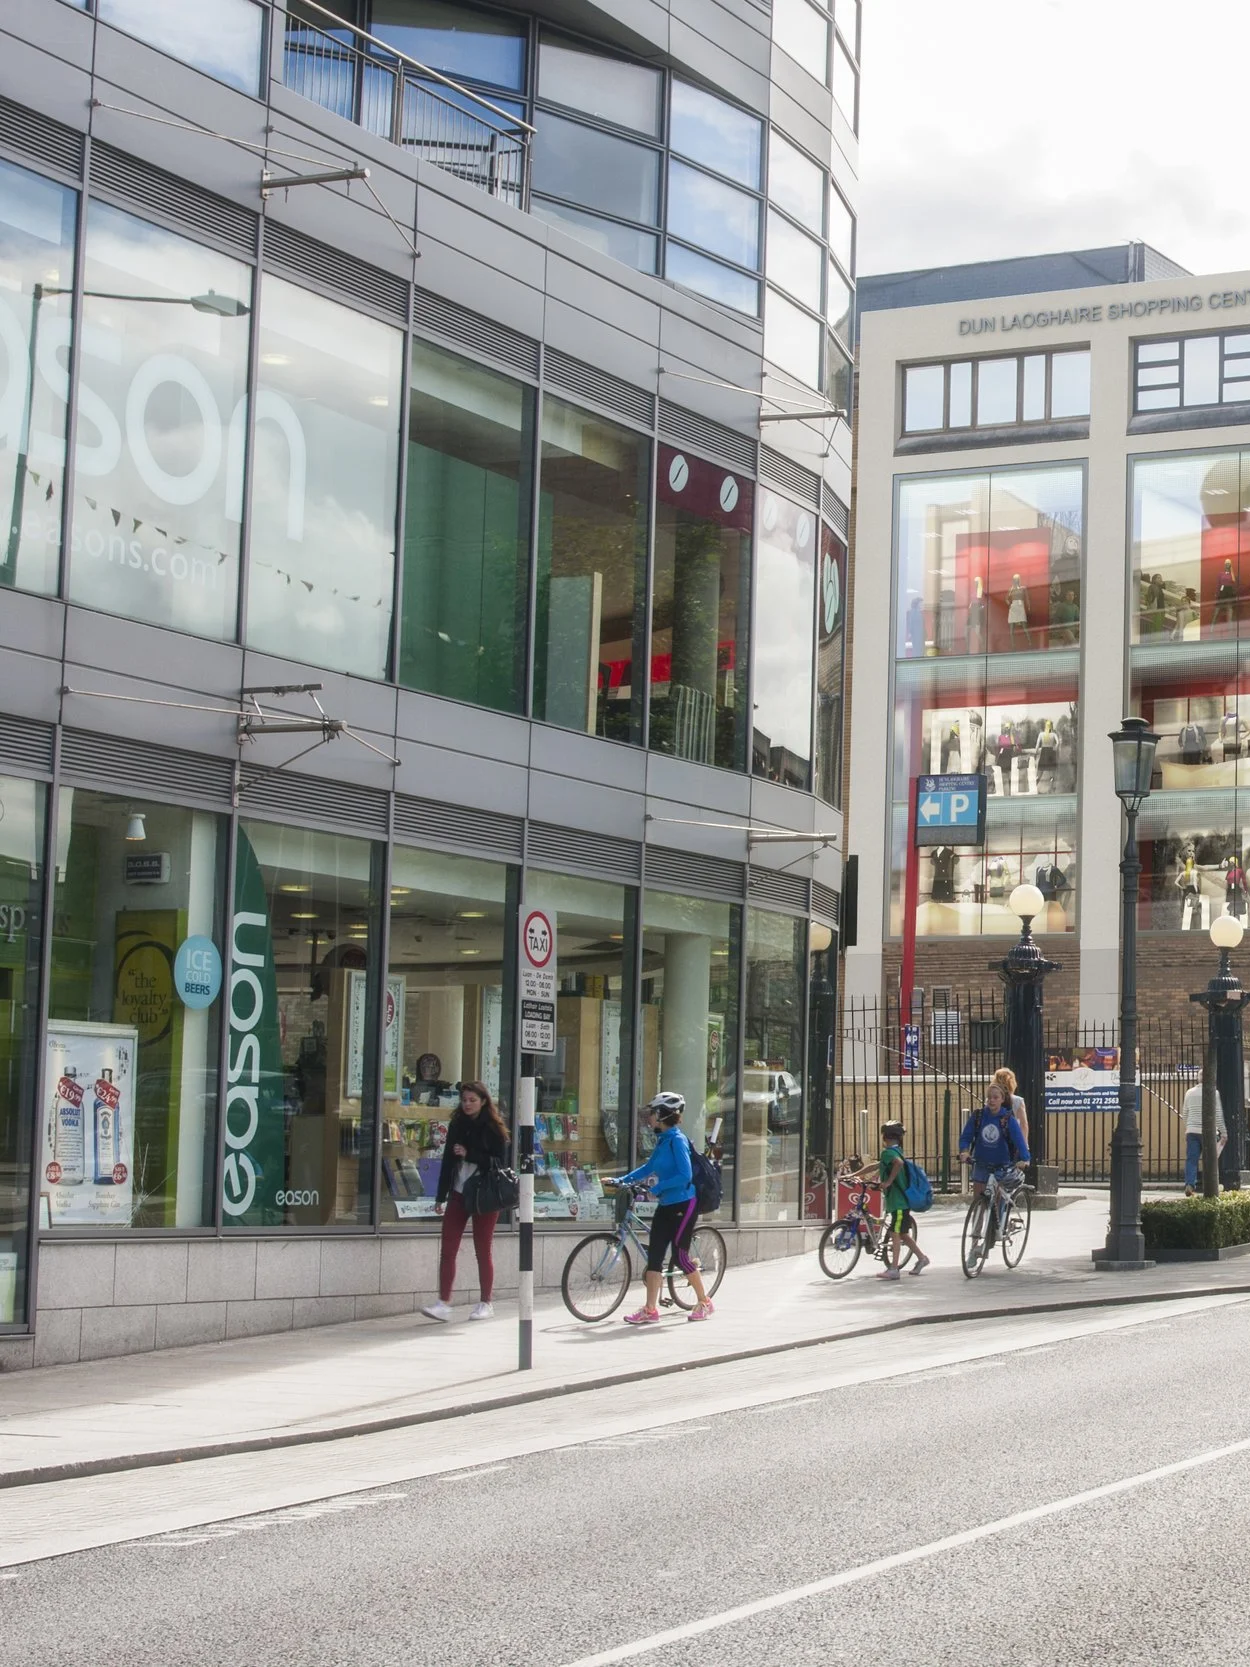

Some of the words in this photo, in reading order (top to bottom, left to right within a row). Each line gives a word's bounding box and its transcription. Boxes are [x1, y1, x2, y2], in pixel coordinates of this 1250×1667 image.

[959, 317, 995, 335] DUN
[1001, 305, 1103, 332] LAOGHAIRE
[1107, 294, 1202, 320] SHOPPING
[950, 793, 970, 822] P
[529, 936, 548, 952] TAXI
[186, 948, 212, 972] ICE
[185, 970, 211, 983] COLD
[184, 982, 211, 995] BEERS
[122, 990, 167, 1007] loyalty
[222, 911, 267, 1216] eason
[60, 1108, 81, 1116] ABSOLUT
[275, 1189, 319, 1206] eason
